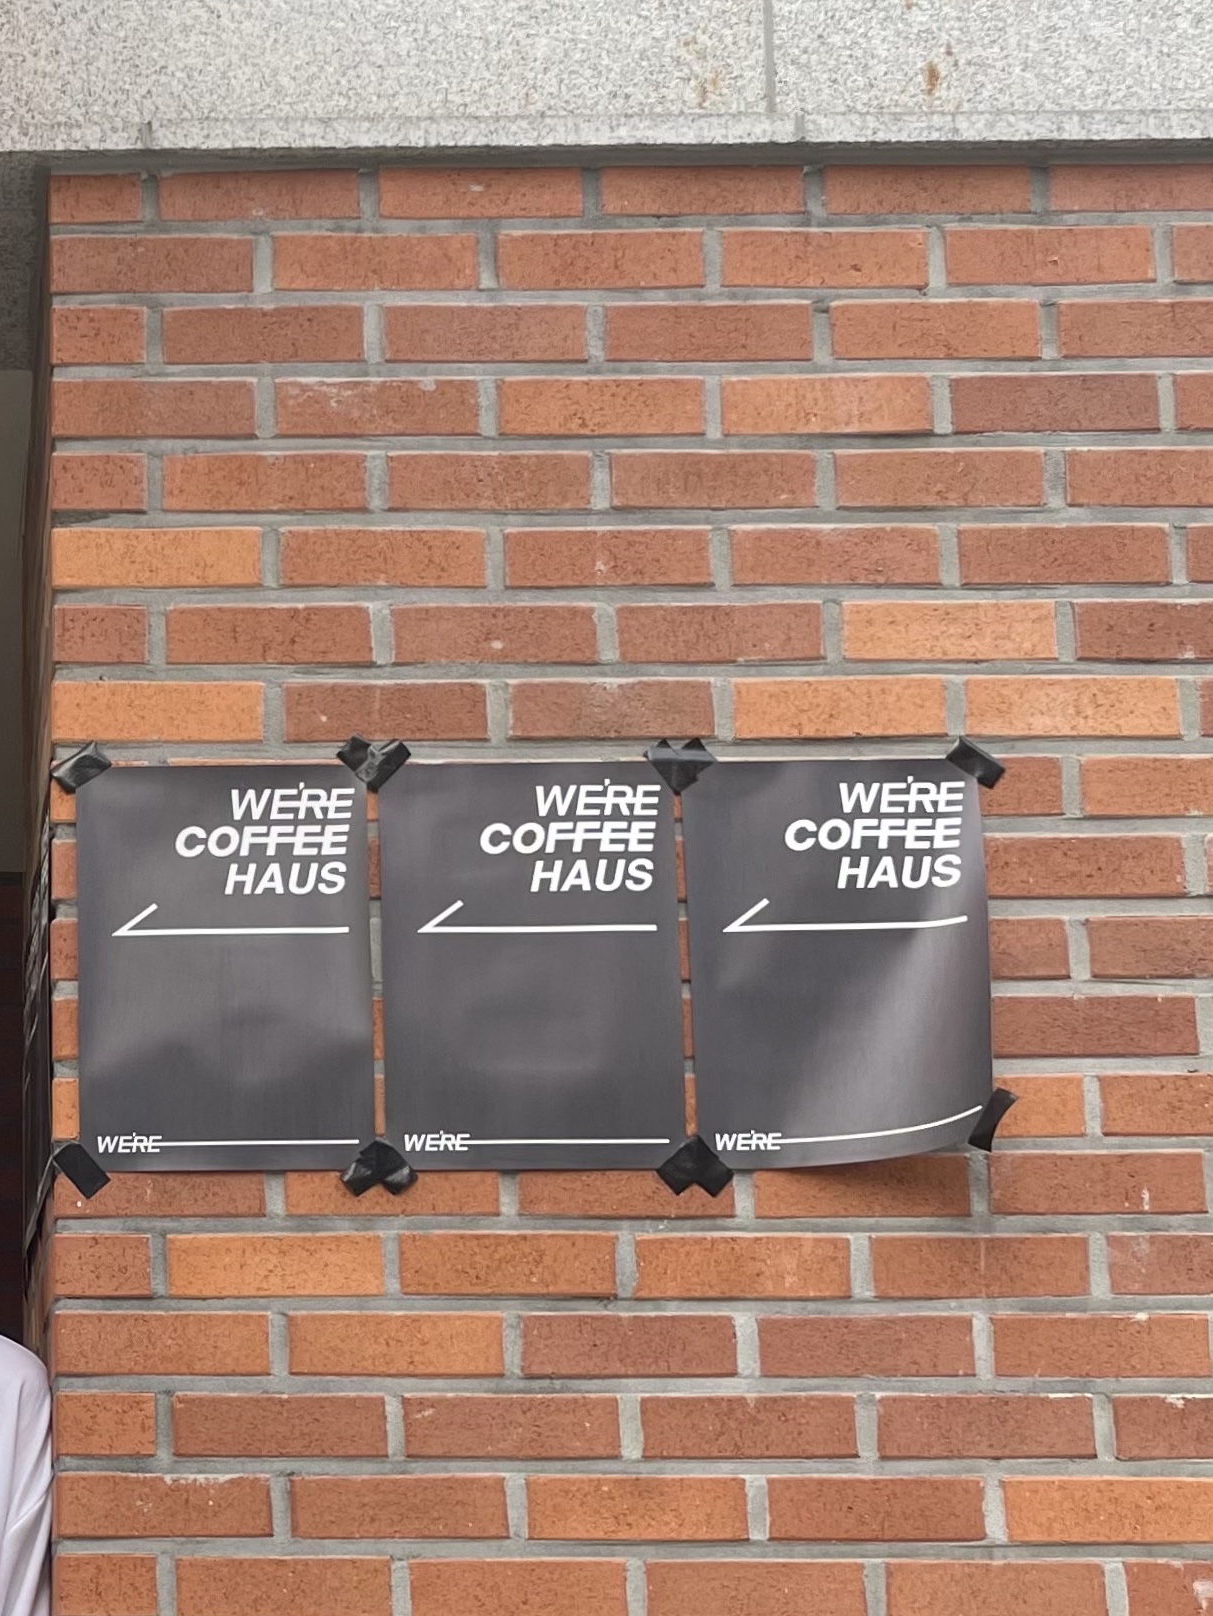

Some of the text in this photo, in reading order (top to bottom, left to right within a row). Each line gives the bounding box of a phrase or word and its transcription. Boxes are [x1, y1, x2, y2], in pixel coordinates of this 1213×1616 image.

[231, 782, 355, 820] WE'RE
[536, 778, 661, 817] WE'RE
[840, 775, 965, 814] WE'RE
[175, 824, 350, 858] COFFEE
[480, 821, 655, 855] COFFEE
[784, 817, 962, 851] COFFEE
[224, 861, 347, 895] HAUS
[530, 858, 654, 892] HAUS
[837, 853, 962, 889] HAUS
